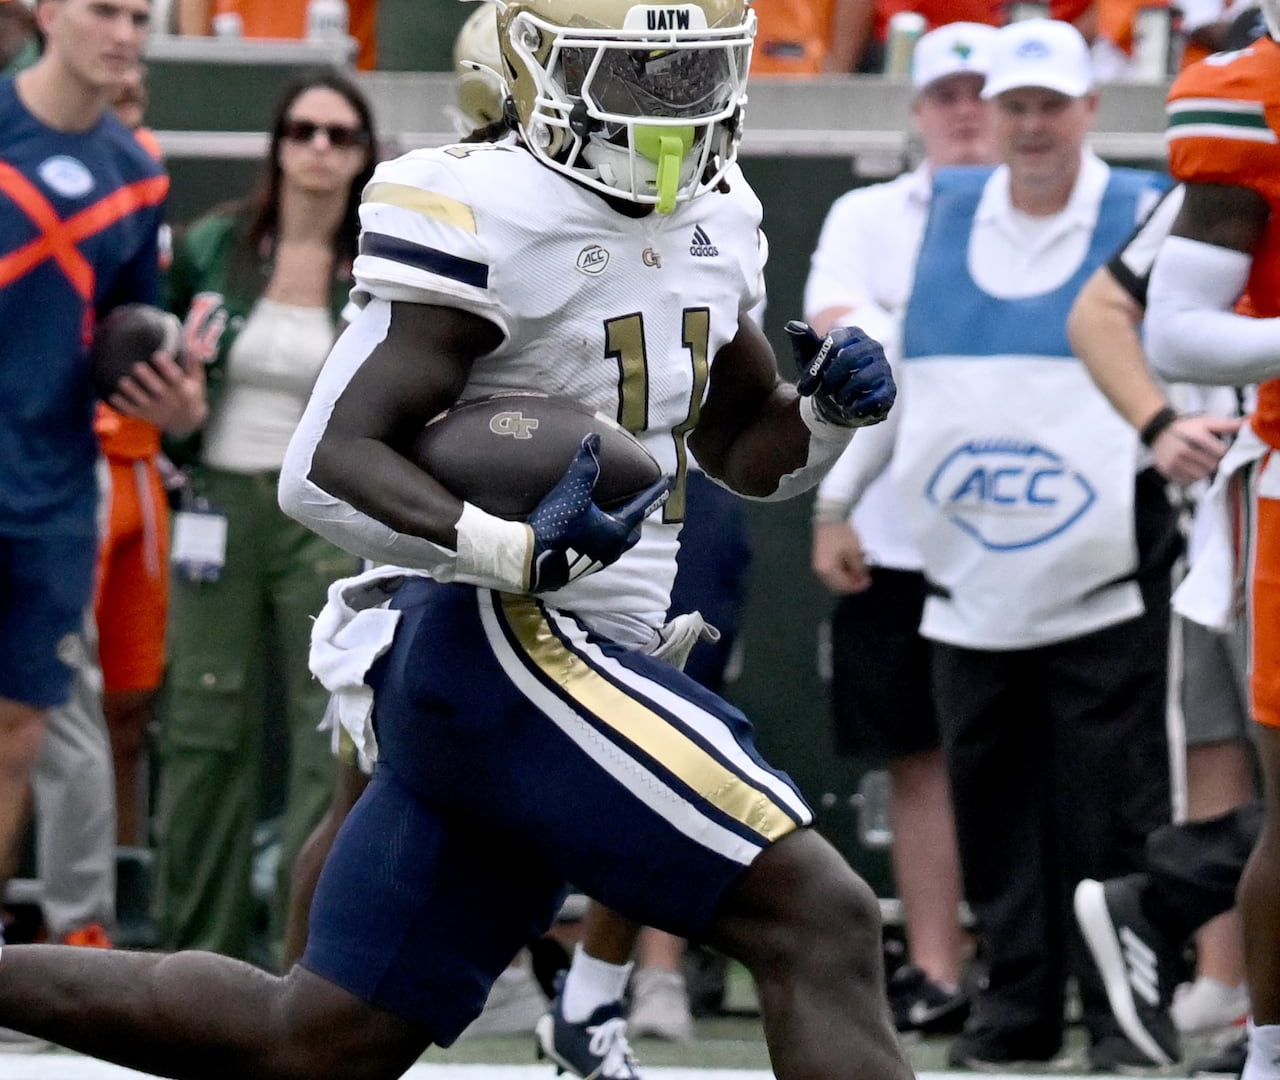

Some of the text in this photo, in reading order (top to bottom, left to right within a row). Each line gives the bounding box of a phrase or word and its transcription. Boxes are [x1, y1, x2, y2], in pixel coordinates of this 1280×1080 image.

[646, 9, 690, 31] UATW
[582, 248, 605, 266] ACC
[689, 245, 719, 258] adidas
[809, 335, 835, 377] ADIZERO
[603, 306, 711, 525] 11
[950, 467, 1065, 504] ACC
